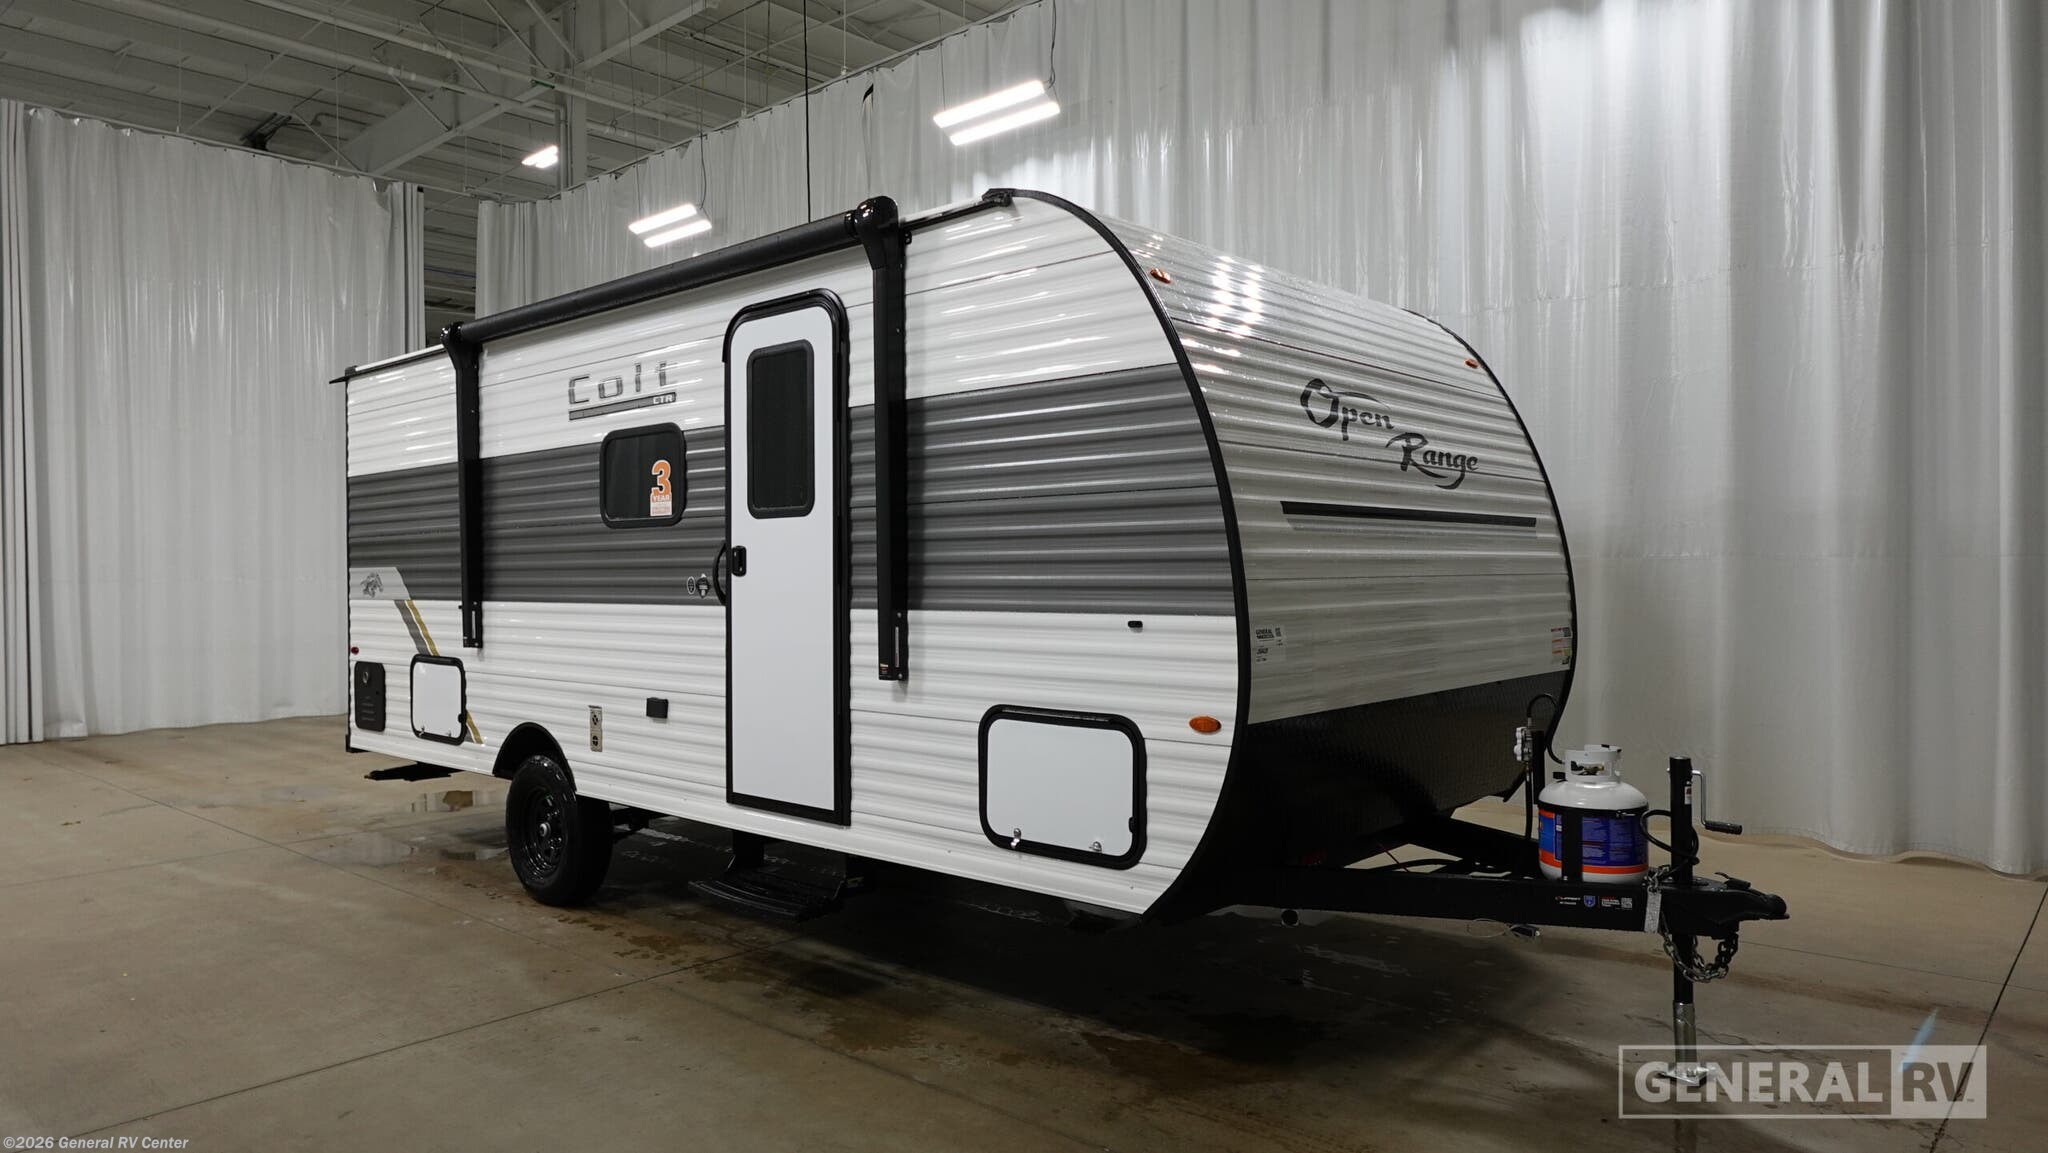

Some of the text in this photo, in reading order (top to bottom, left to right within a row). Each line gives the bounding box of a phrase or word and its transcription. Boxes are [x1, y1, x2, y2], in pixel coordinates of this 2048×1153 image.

[568, 361, 677, 405] Colt
[1300, 378, 1394, 441] Open
[651, 459, 671, 496] 3
[1385, 432, 1478, 489] Range
